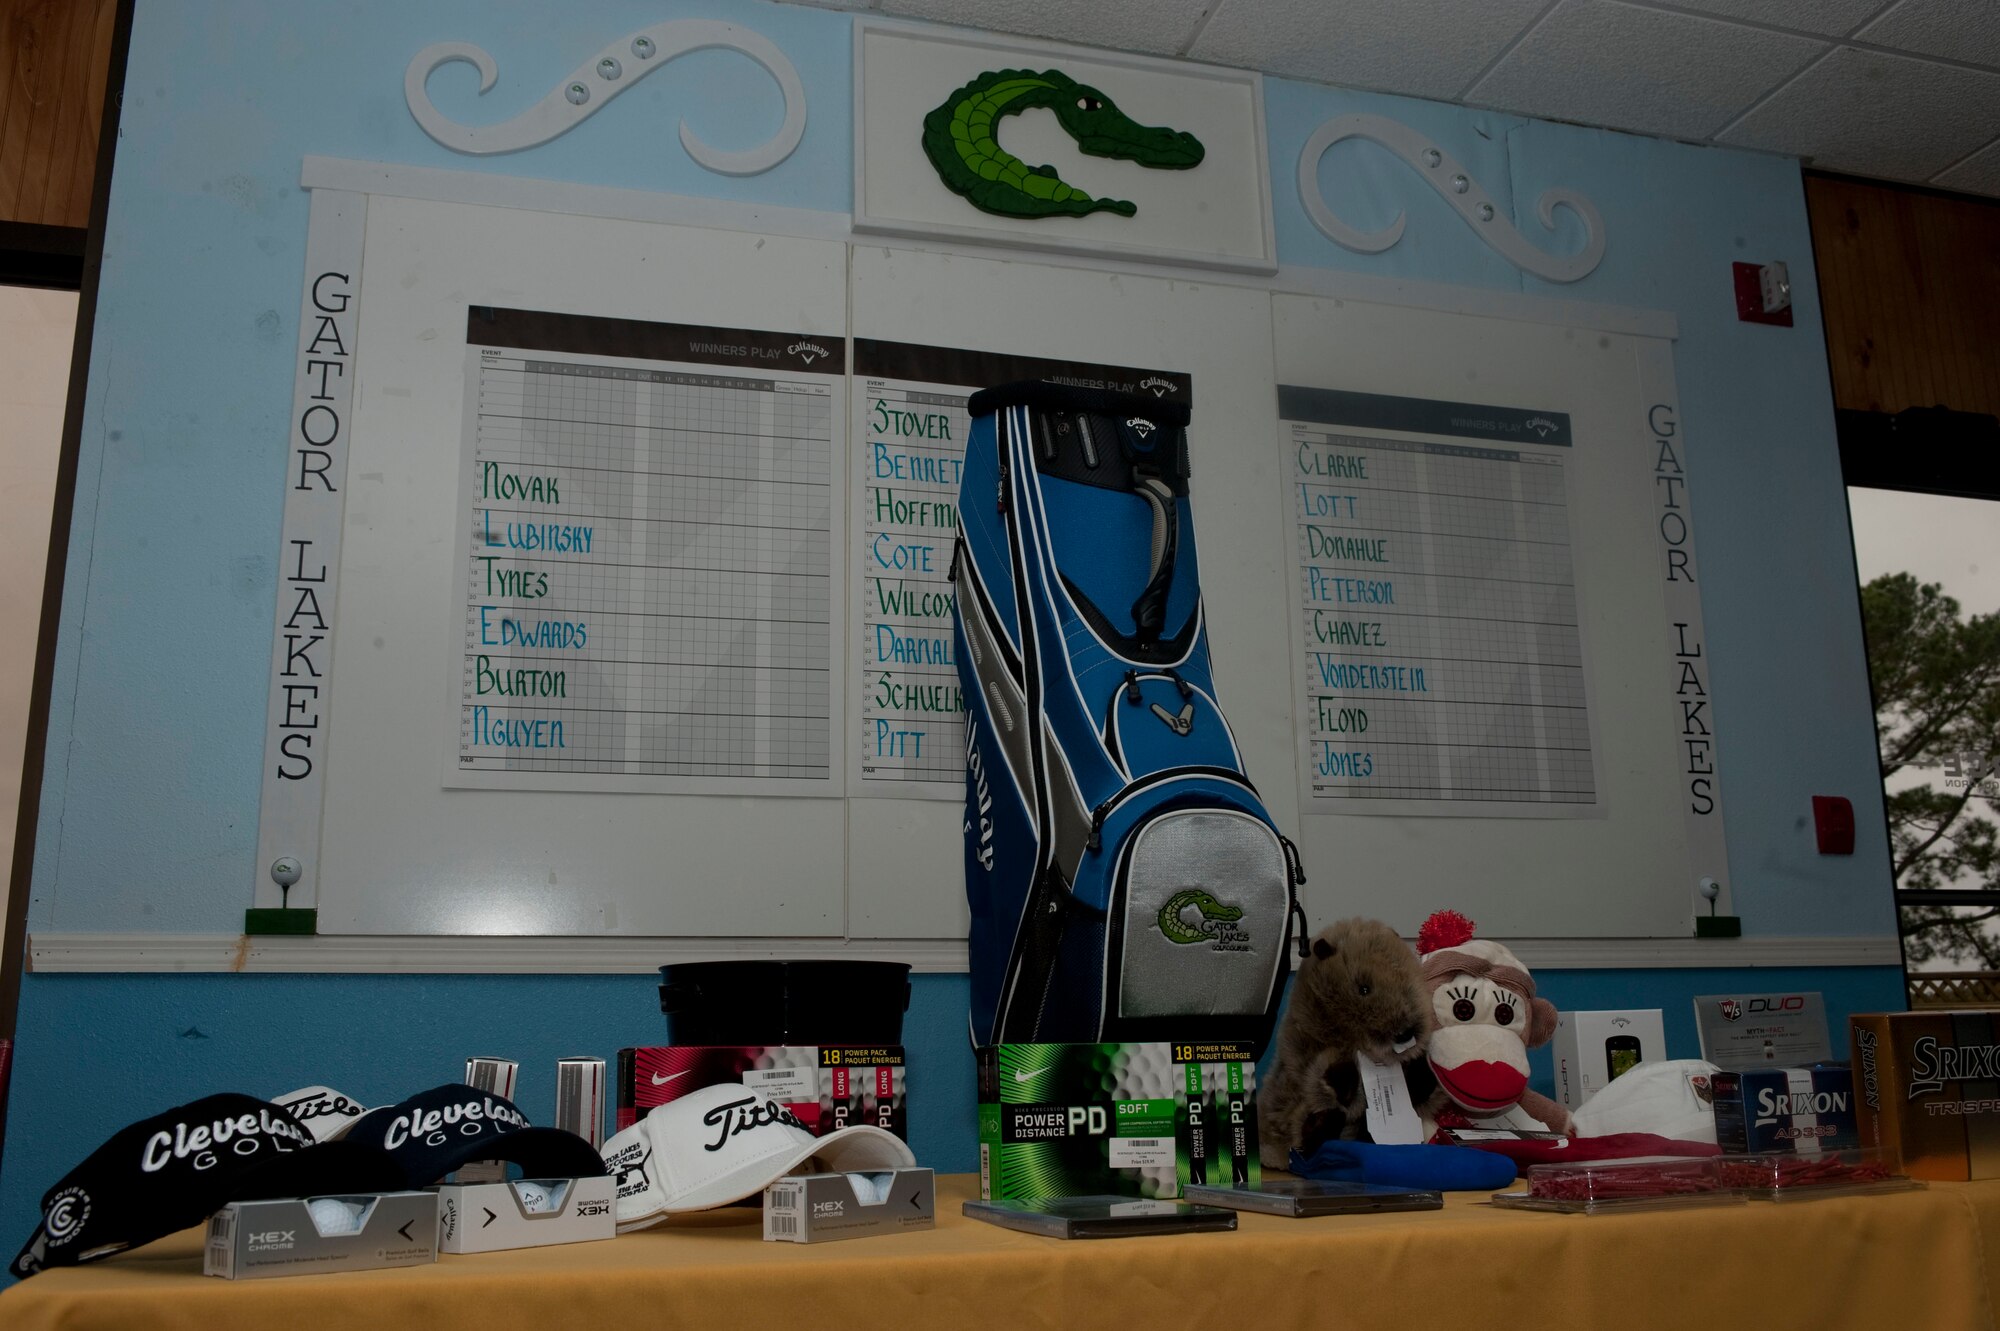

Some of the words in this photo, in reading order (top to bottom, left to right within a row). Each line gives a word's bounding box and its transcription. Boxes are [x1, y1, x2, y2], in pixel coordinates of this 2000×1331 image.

[689, 341, 747, 356] WINNERS
[751, 347, 781, 360] PLAY
[787, 341, 830, 358] Callaway
[295, 272, 351, 492] GATOR
[1052, 376, 1104, 389] WINNERS
[1108, 382, 1135, 393] PLAY
[1140, 376, 1178, 392] Callaway
[873, 399, 951, 440] STOVER
[1126, 416, 1157, 431] Callaway
[1450, 417, 1496, 431] WINNERS
[1498, 422, 1522, 432] PLAY
[1526, 417, 1559, 432] Callaway
[1298, 442, 1369, 479] CLARKE
[484, 461, 560, 504] NOVAK
[1302, 483, 1357, 519] LOTT
[486, 510, 593, 554] LUBINSKY
[1307, 524, 1389, 562] DONAHUE
[873, 532, 934, 572] COTE
[478, 556, 548, 598] TYNES
[1310, 566, 1394, 604] PETERSON
[876, 578, 954, 618] WILCOX
[1648, 404, 1695, 583] GATOR
[1673, 623, 1714, 815] LAKES
[480, 606, 586, 649] EDWARDS
[1314, 609, 1387, 646] CHAVEZ
[278, 540, 329, 780] LAKES
[1316, 652, 1427, 692] VONDENSTEIN
[476, 654, 566, 698] BURTON
[474, 706, 565, 748] NGUYEN
[1318, 696, 1368, 733] FLOYD
[877, 719, 925, 758] PITT
[1320, 740, 1372, 777] JONES
[964, 708, 994, 872] llaway
[1201, 920, 1238, 933] GATOR
[1220, 932, 1250, 944] LAKES
[1748, 996, 1804, 1012] DUO
[822, 1050, 840, 1064] 18
[1175, 1046, 1192, 1060] 18
[837, 1071, 845, 1096] LONG
[1190, 1067, 1198, 1092] SOFT
[1561, 1059, 1570, 1104] upro
[1860, 1029, 1881, 1112] SRIXON
[281, 1092, 368, 1120] Title
[878, 1104, 892, 1128] PD
[1118, 1104, 1149, 1114] SOFT
[1188, 1102, 1202, 1126] PD
[1230, 1100, 1244, 1124] PD
[1756, 1087, 1848, 1117] SRIXON
[835, 1106, 849, 1130] PD
[1015, 1114, 1065, 1127] POWER
[1015, 1128, 1066, 1138] DISTANCE
[1068, 1105, 1107, 1136] PD
[606, 1153, 620, 1164] TOR
[620, 1142, 641, 1156] LAKES
[1192, 1128, 1200, 1158] POWER
[1234, 1127, 1242, 1156] POWER
[614, 1150, 644, 1166] COURSE
[446, 1198, 456, 1241] Callaway
[576, 1205, 610, 1216] HEX
[814, 1200, 844, 1212] HEX
[248, 1230, 296, 1244] HEX
[248, 1242, 294, 1252] CHROME
